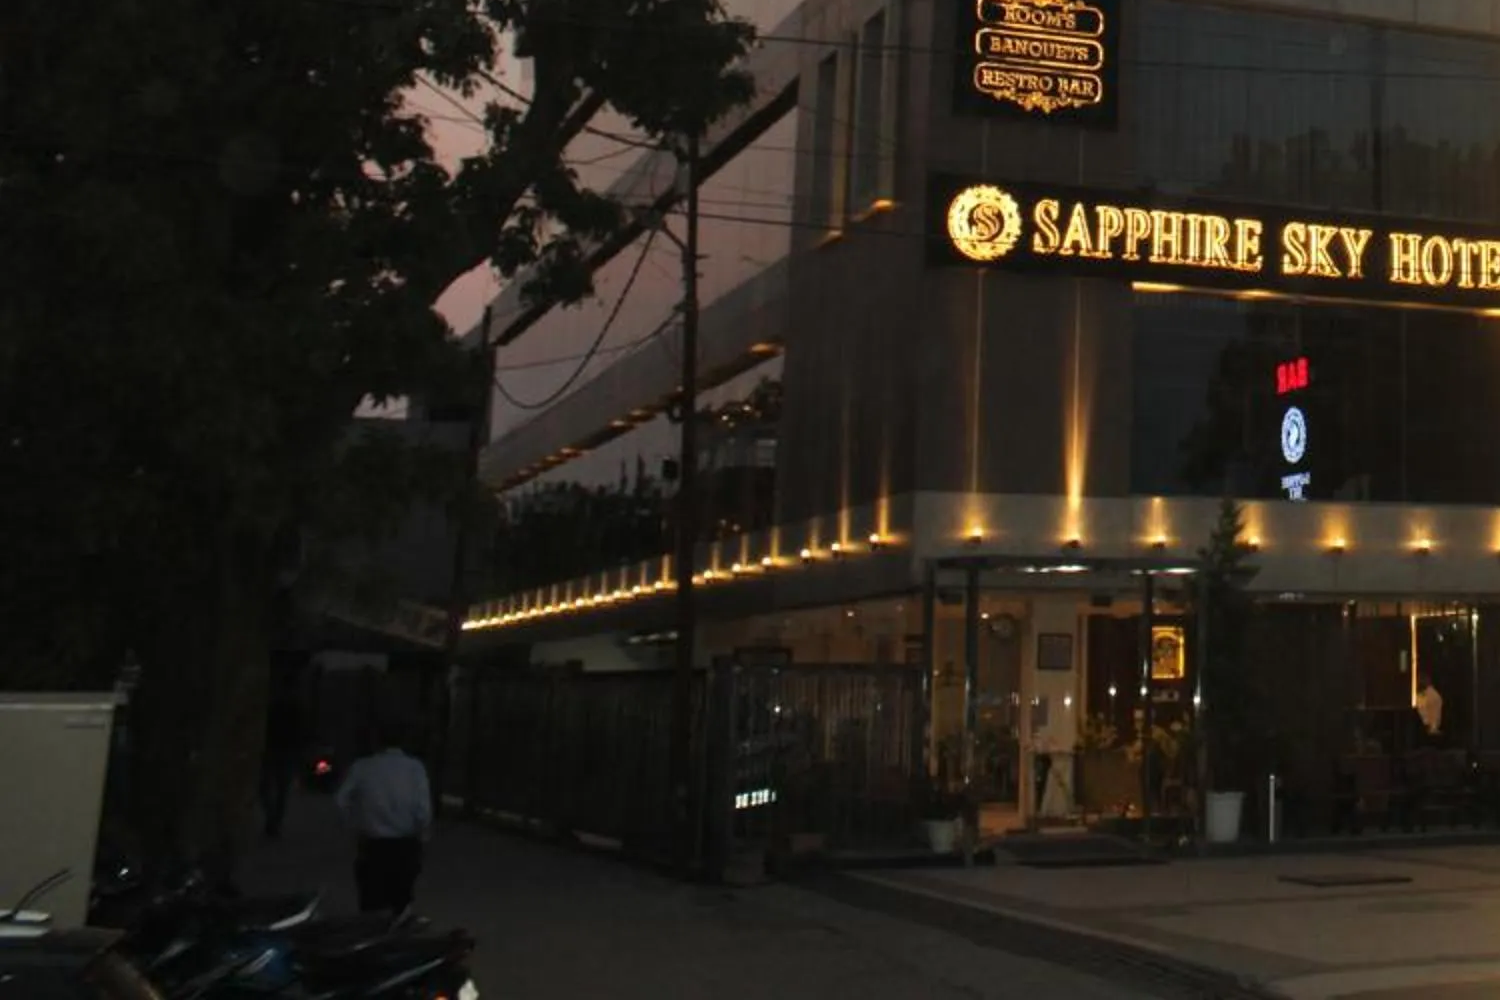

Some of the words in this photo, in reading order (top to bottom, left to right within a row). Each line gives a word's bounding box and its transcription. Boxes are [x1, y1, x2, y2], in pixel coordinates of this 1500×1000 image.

[989, 35, 1091, 61] BANQUETS
[981, 67, 1052, 90] RESTRO
[1057, 74, 1096, 97] BAR
[1032, 199, 1263, 272] SAPPHIRE
[1282, 222, 1373, 278] SKY
